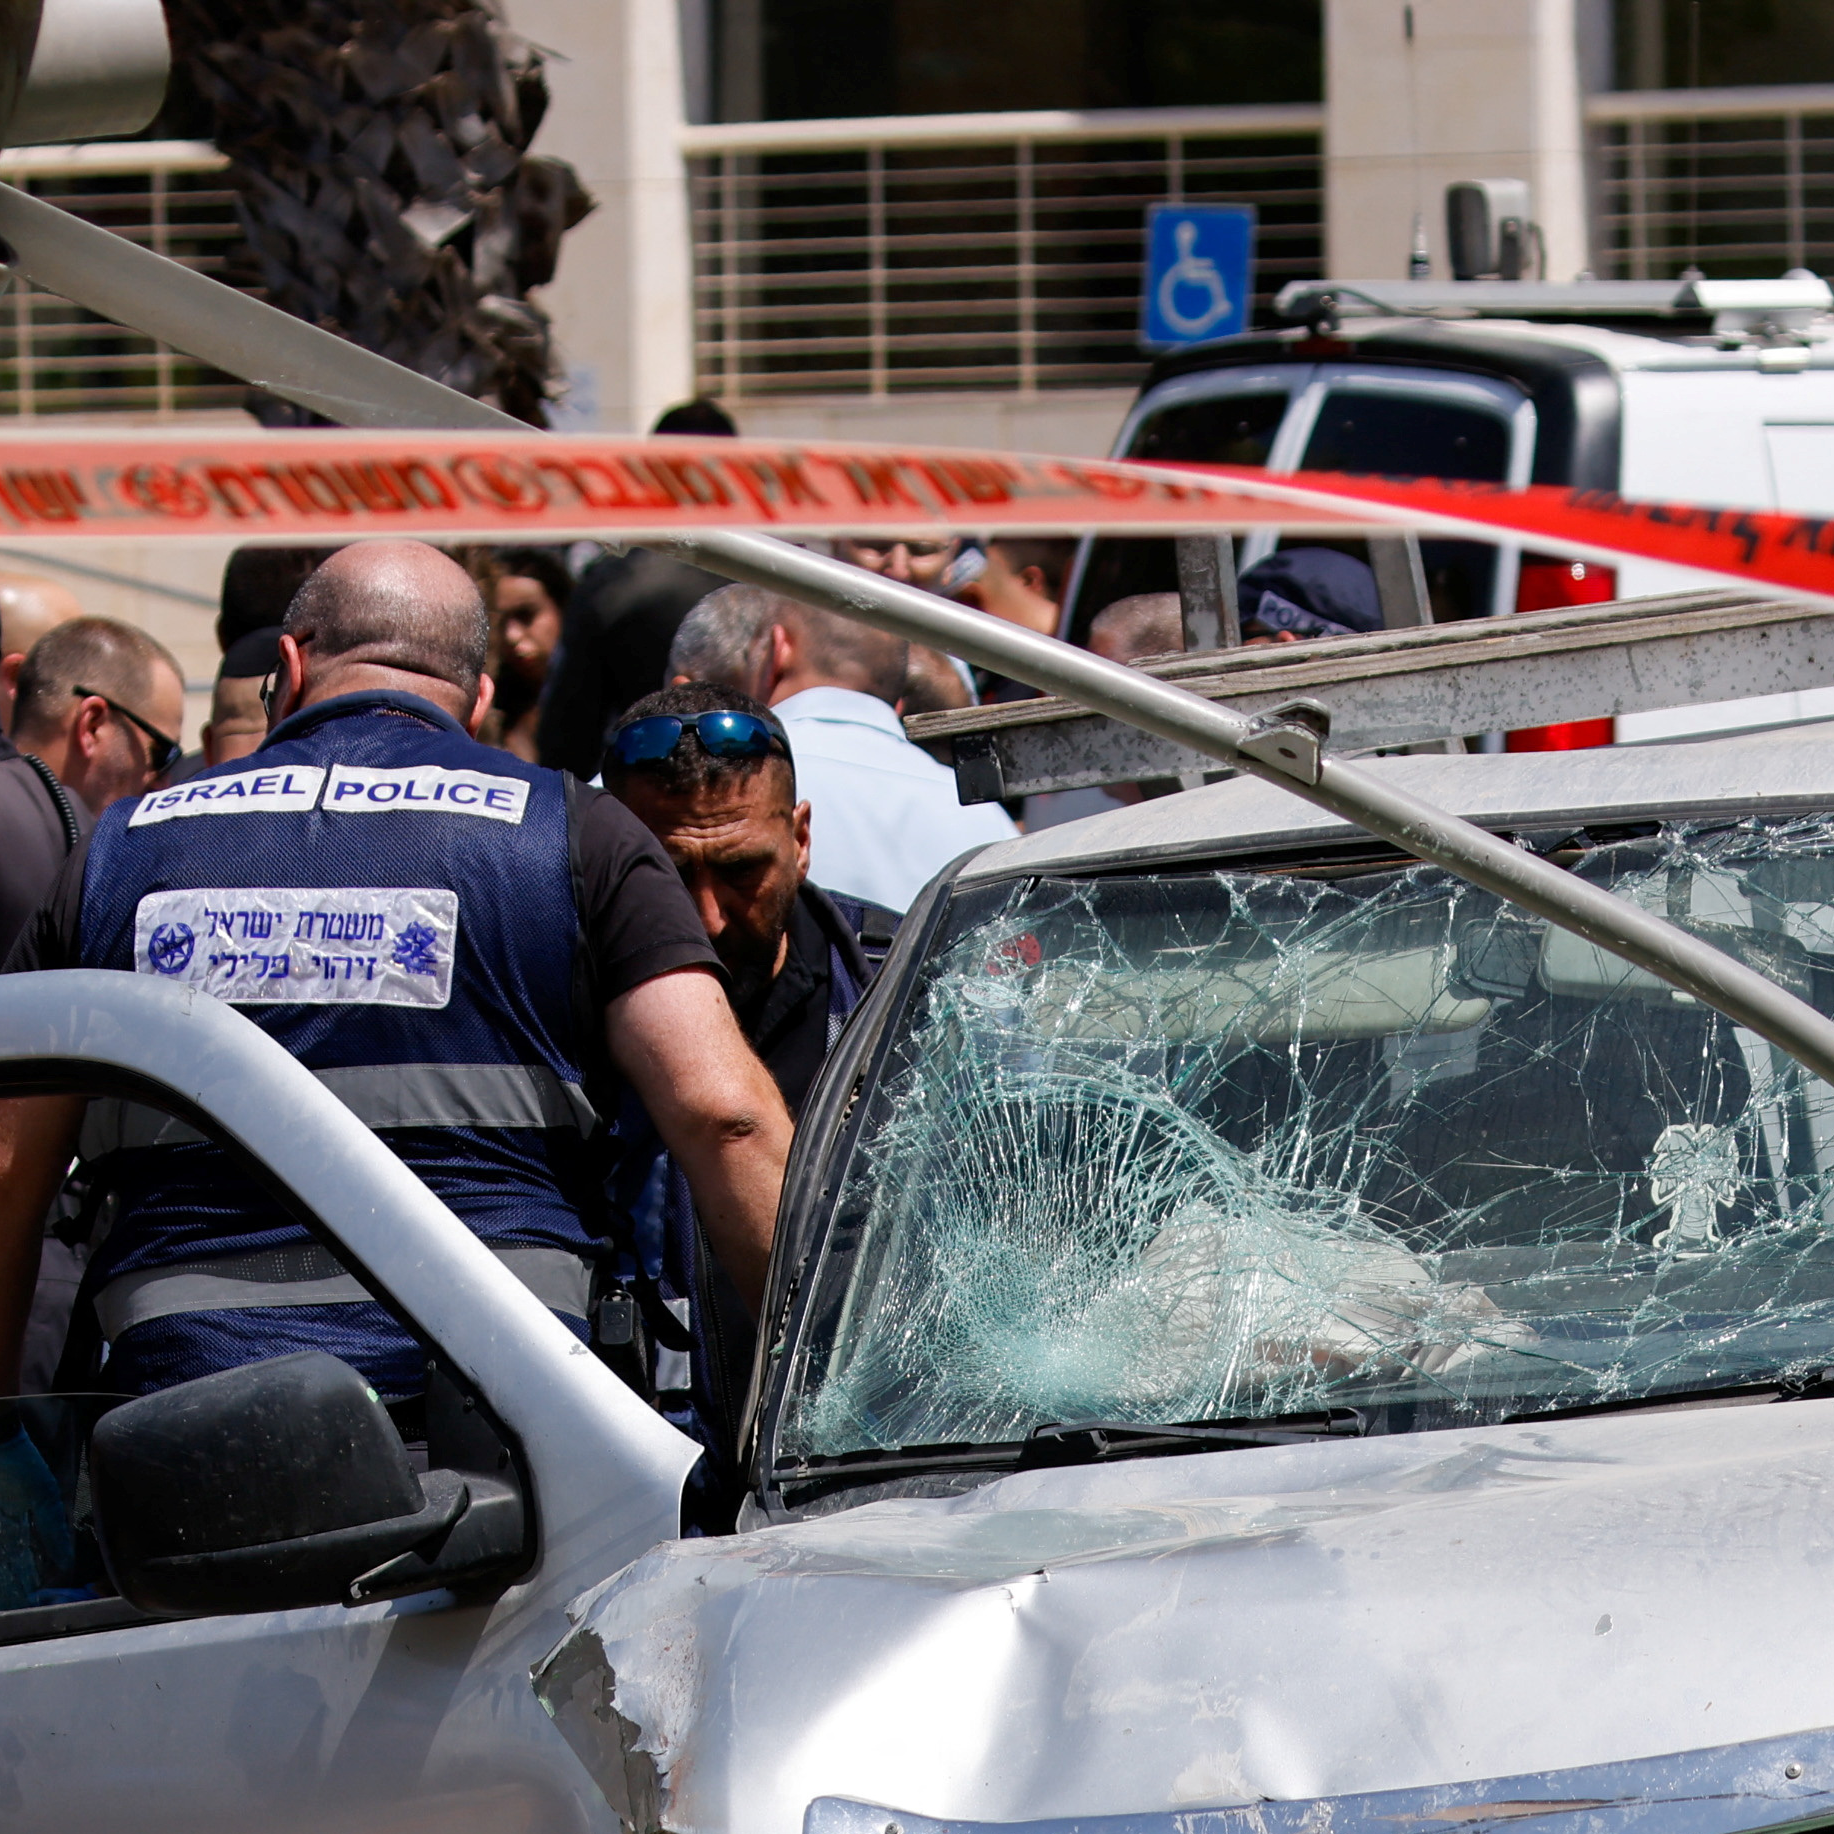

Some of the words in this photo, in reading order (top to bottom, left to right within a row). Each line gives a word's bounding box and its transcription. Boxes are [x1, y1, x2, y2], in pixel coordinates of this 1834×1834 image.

[144, 774, 306, 813] ISRAEL
[333, 781, 515, 811] POLICE
[204, 908, 283, 939] ישראל
[293, 912, 385, 941] משטרת
[208, 950, 290, 979] פלילי
[312, 955, 377, 981] זיהוי
